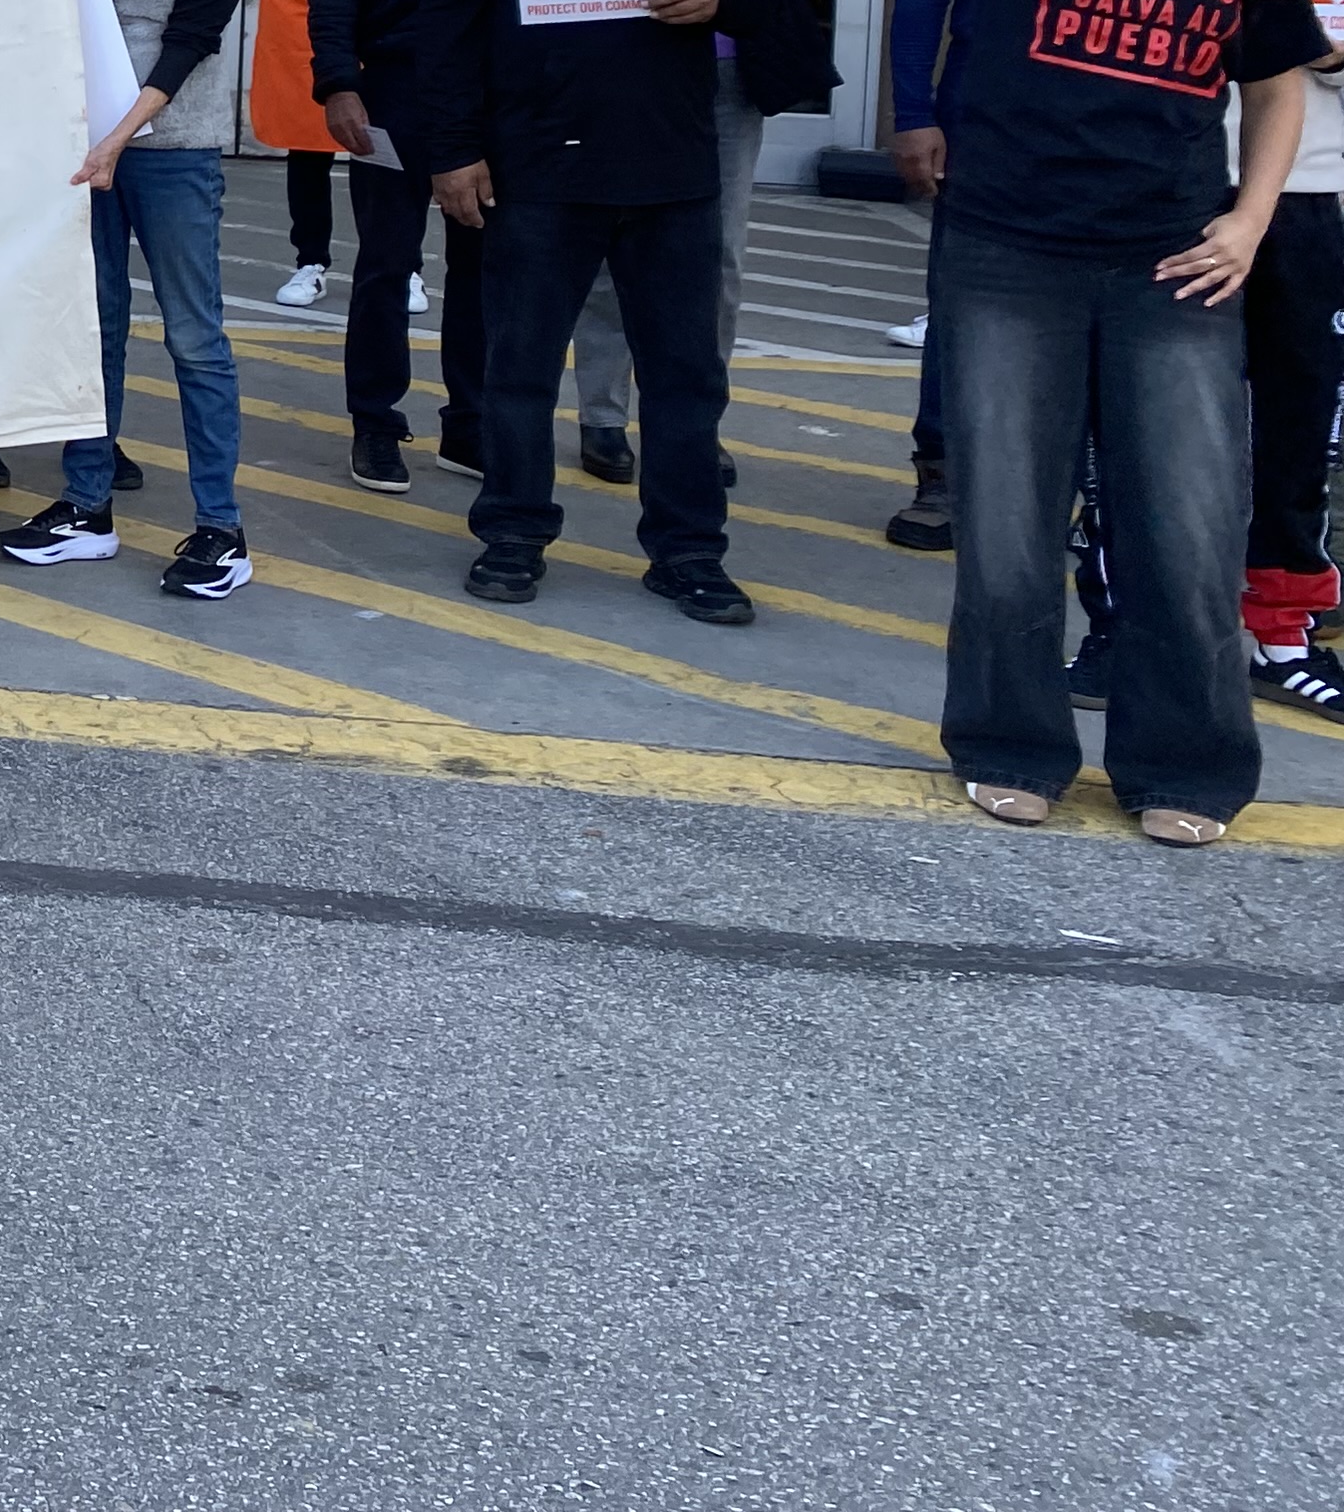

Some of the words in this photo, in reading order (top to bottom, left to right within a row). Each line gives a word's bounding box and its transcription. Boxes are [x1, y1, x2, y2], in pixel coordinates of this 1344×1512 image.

[527, 2, 576, 16] PROTECT
[580, 1, 603, 13] OUR
[1186, 4, 1221, 37] AL
[1053, 8, 1221, 76] PUEBLO
